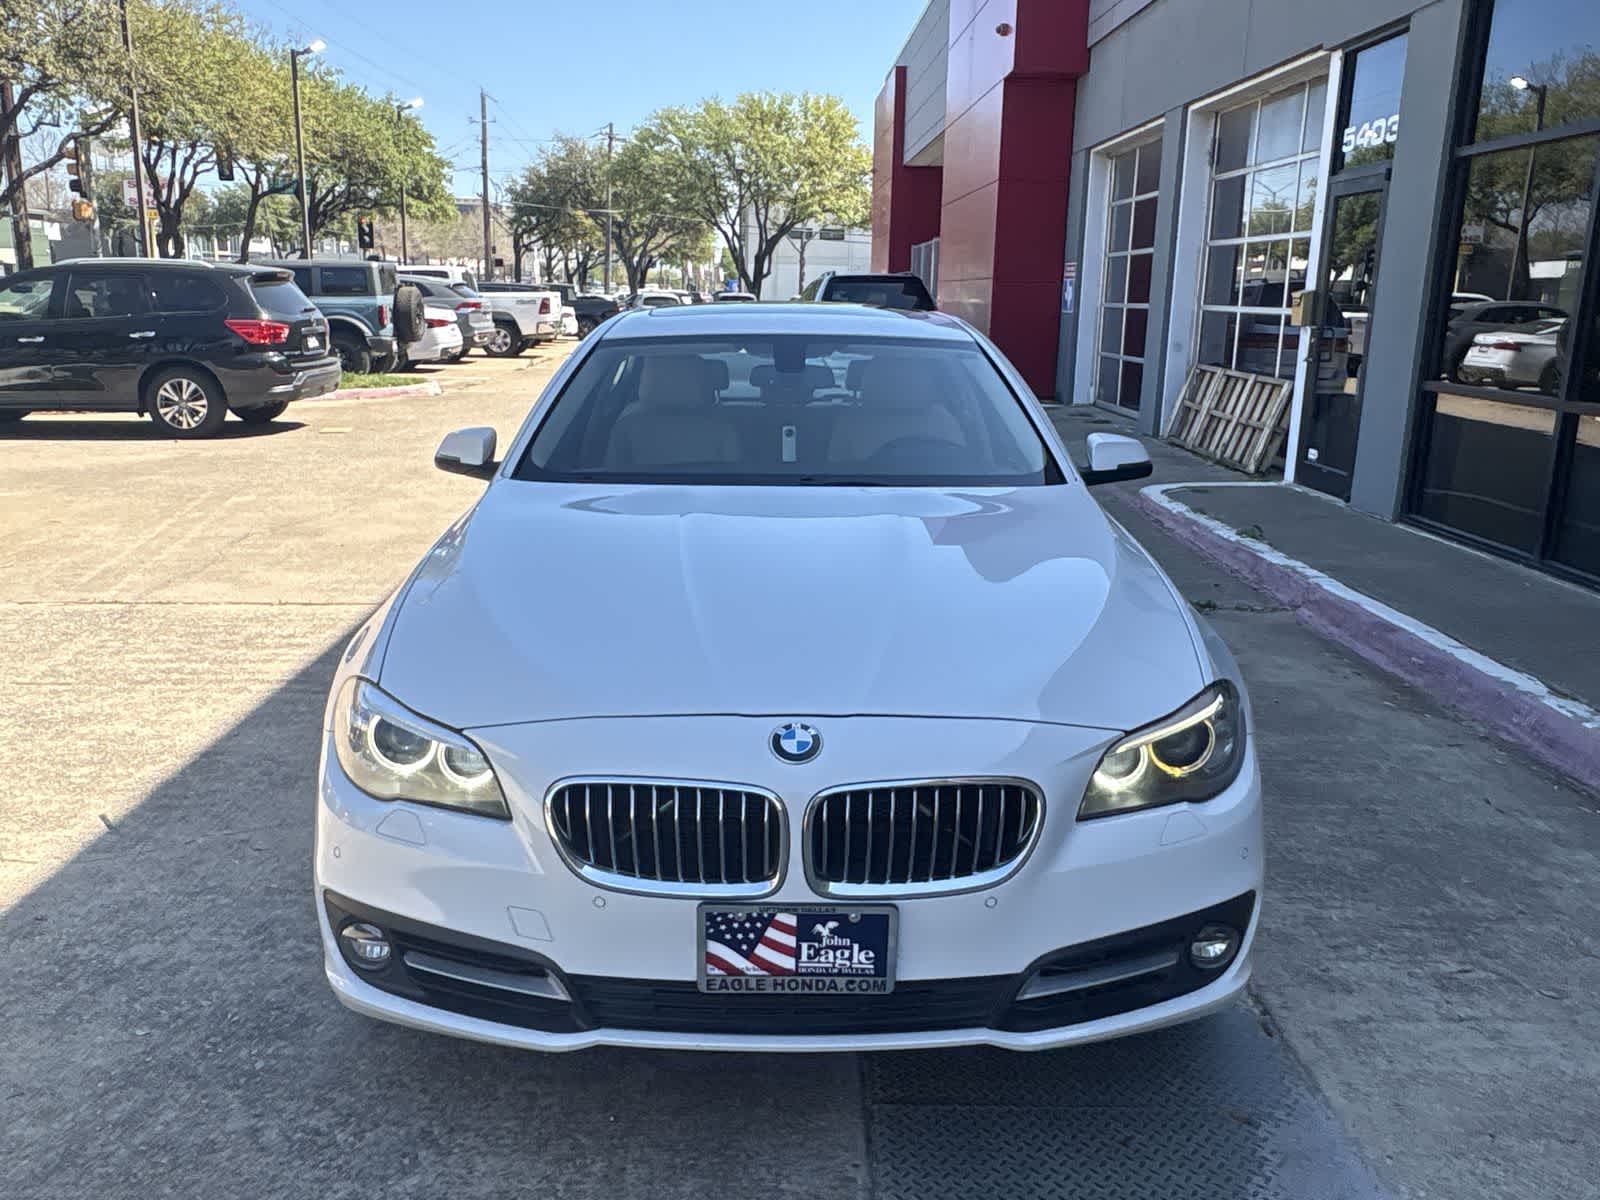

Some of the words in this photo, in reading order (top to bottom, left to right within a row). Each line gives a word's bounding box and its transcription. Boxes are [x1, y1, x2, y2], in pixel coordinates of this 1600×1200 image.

[1342, 114, 1399, 152] 5403
[820, 936, 851, 947] John
[798, 942, 876, 968] Eagle
[706, 978, 767, 992] EAGLE
[773, 978, 887, 992] HONDA.COM
